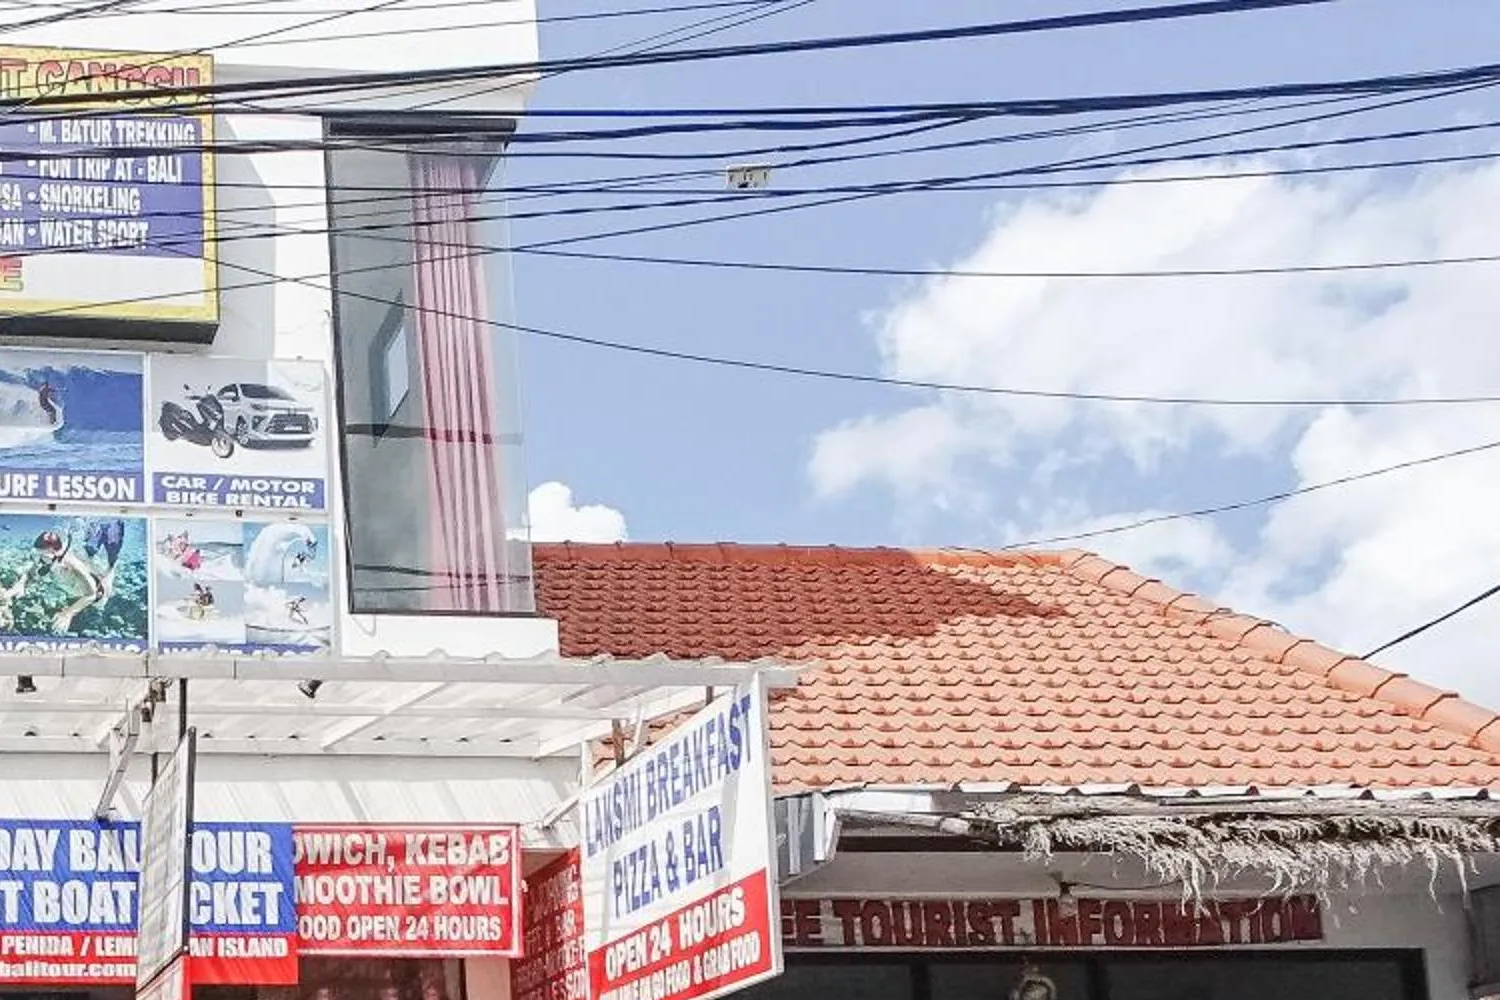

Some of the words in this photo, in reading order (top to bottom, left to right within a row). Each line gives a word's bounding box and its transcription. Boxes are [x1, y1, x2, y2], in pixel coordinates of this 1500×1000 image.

[61, 120, 111, 144] BATUR
[115, 121, 196, 147] TREKKING
[147, 156, 182, 182] BALI
[39, 186, 142, 215] SNORKELING
[39, 219, 94, 246] WATER
[97, 221, 150, 250] SPORT
[45, 473, 136, 501] LESSON
[161, 475, 206, 491] CAR
[230, 478, 316, 494] MOTOR
[167, 490, 220, 506] BIKE
[225, 492, 311, 508] RENTAL
[584, 772, 645, 858] LAKSMI
[645, 693, 752, 822] BREAKFAST
[68, 828, 142, 874] BAL
[190, 829, 274, 876] OUR
[403, 832, 510, 866] KEBAB
[612, 838, 663, 920] PIZZA
[665, 829, 681, 895] &
[683, 803, 724, 887] BAR
[32, 880, 138, 925] BOAT
[188, 880, 286, 927] CKET
[297, 874, 423, 906] MOOTHIE
[428, 877, 510, 908] BOWL
[345, 914, 400, 942] OPEN
[404, 916, 430, 943] 24
[433, 916, 502, 943] HOURS
[605, 930, 648, 982] OPEN
[650, 918, 672, 963] 24
[678, 886, 746, 951] HOURS
[833, 899, 1021, 946] TOURIST
[1032, 899, 1324, 946] INFORMATION
[2, 935, 74, 957] PENIDA
[217, 936, 289, 958] ISLAND
